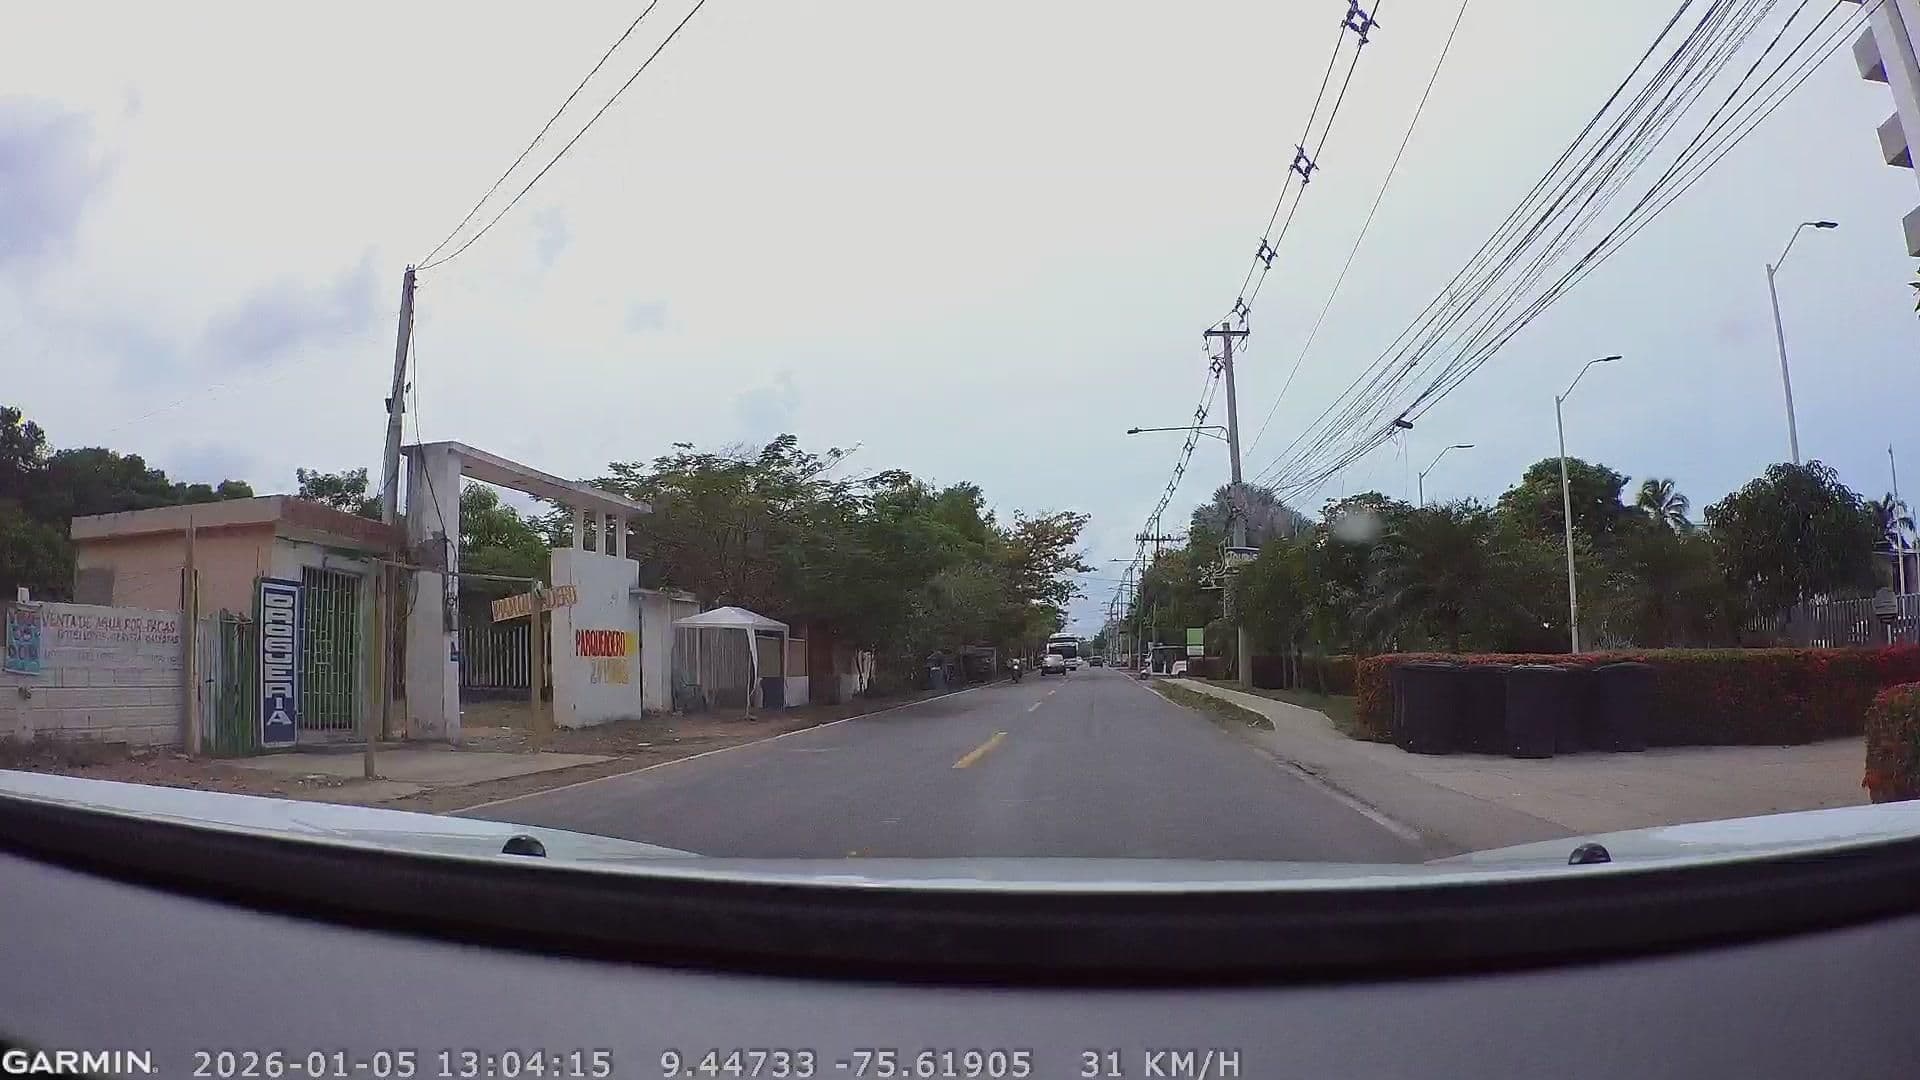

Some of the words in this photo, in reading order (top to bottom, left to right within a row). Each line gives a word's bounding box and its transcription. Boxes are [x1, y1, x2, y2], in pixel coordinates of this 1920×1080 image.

[42, 611, 76, 628] VENTA
[78, 615, 90, 628] DE
[124, 617, 141, 632] POR
[575, 629, 625, 656] PARQUEADERO
[264, 592, 294, 726] DROGUERIA
